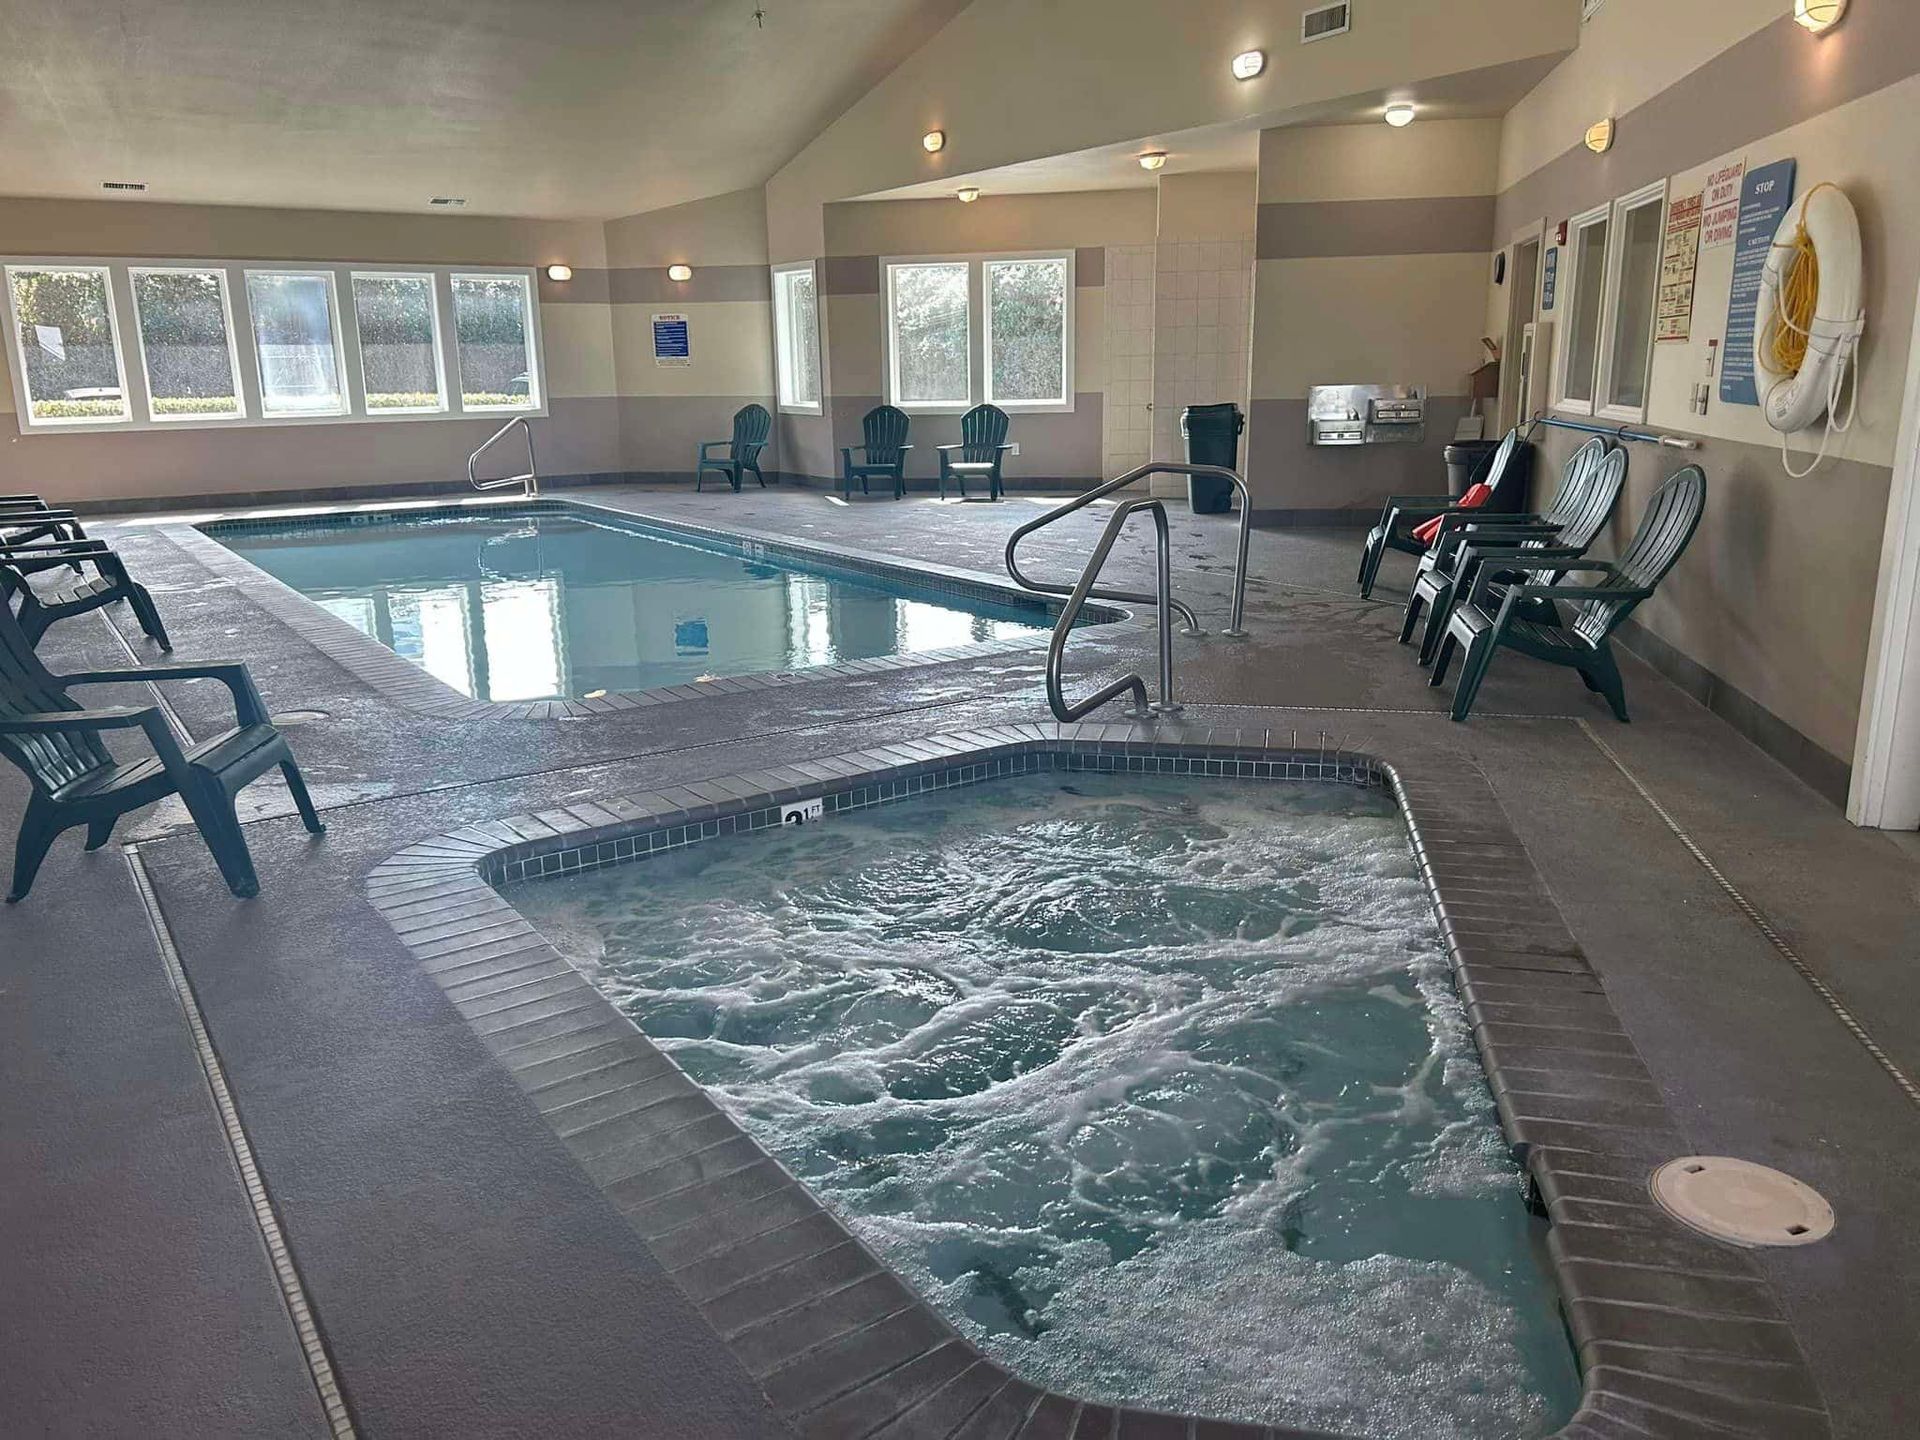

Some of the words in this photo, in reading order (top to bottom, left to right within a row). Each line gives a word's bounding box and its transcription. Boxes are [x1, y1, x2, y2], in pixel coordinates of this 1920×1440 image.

[1754, 180, 1775, 195] STOP
[1703, 213, 1712, 228] NO
[1712, 206, 1737, 225] JUMPING
[1704, 229, 1713, 244] OR
[1713, 225, 1732, 242] DIVING
